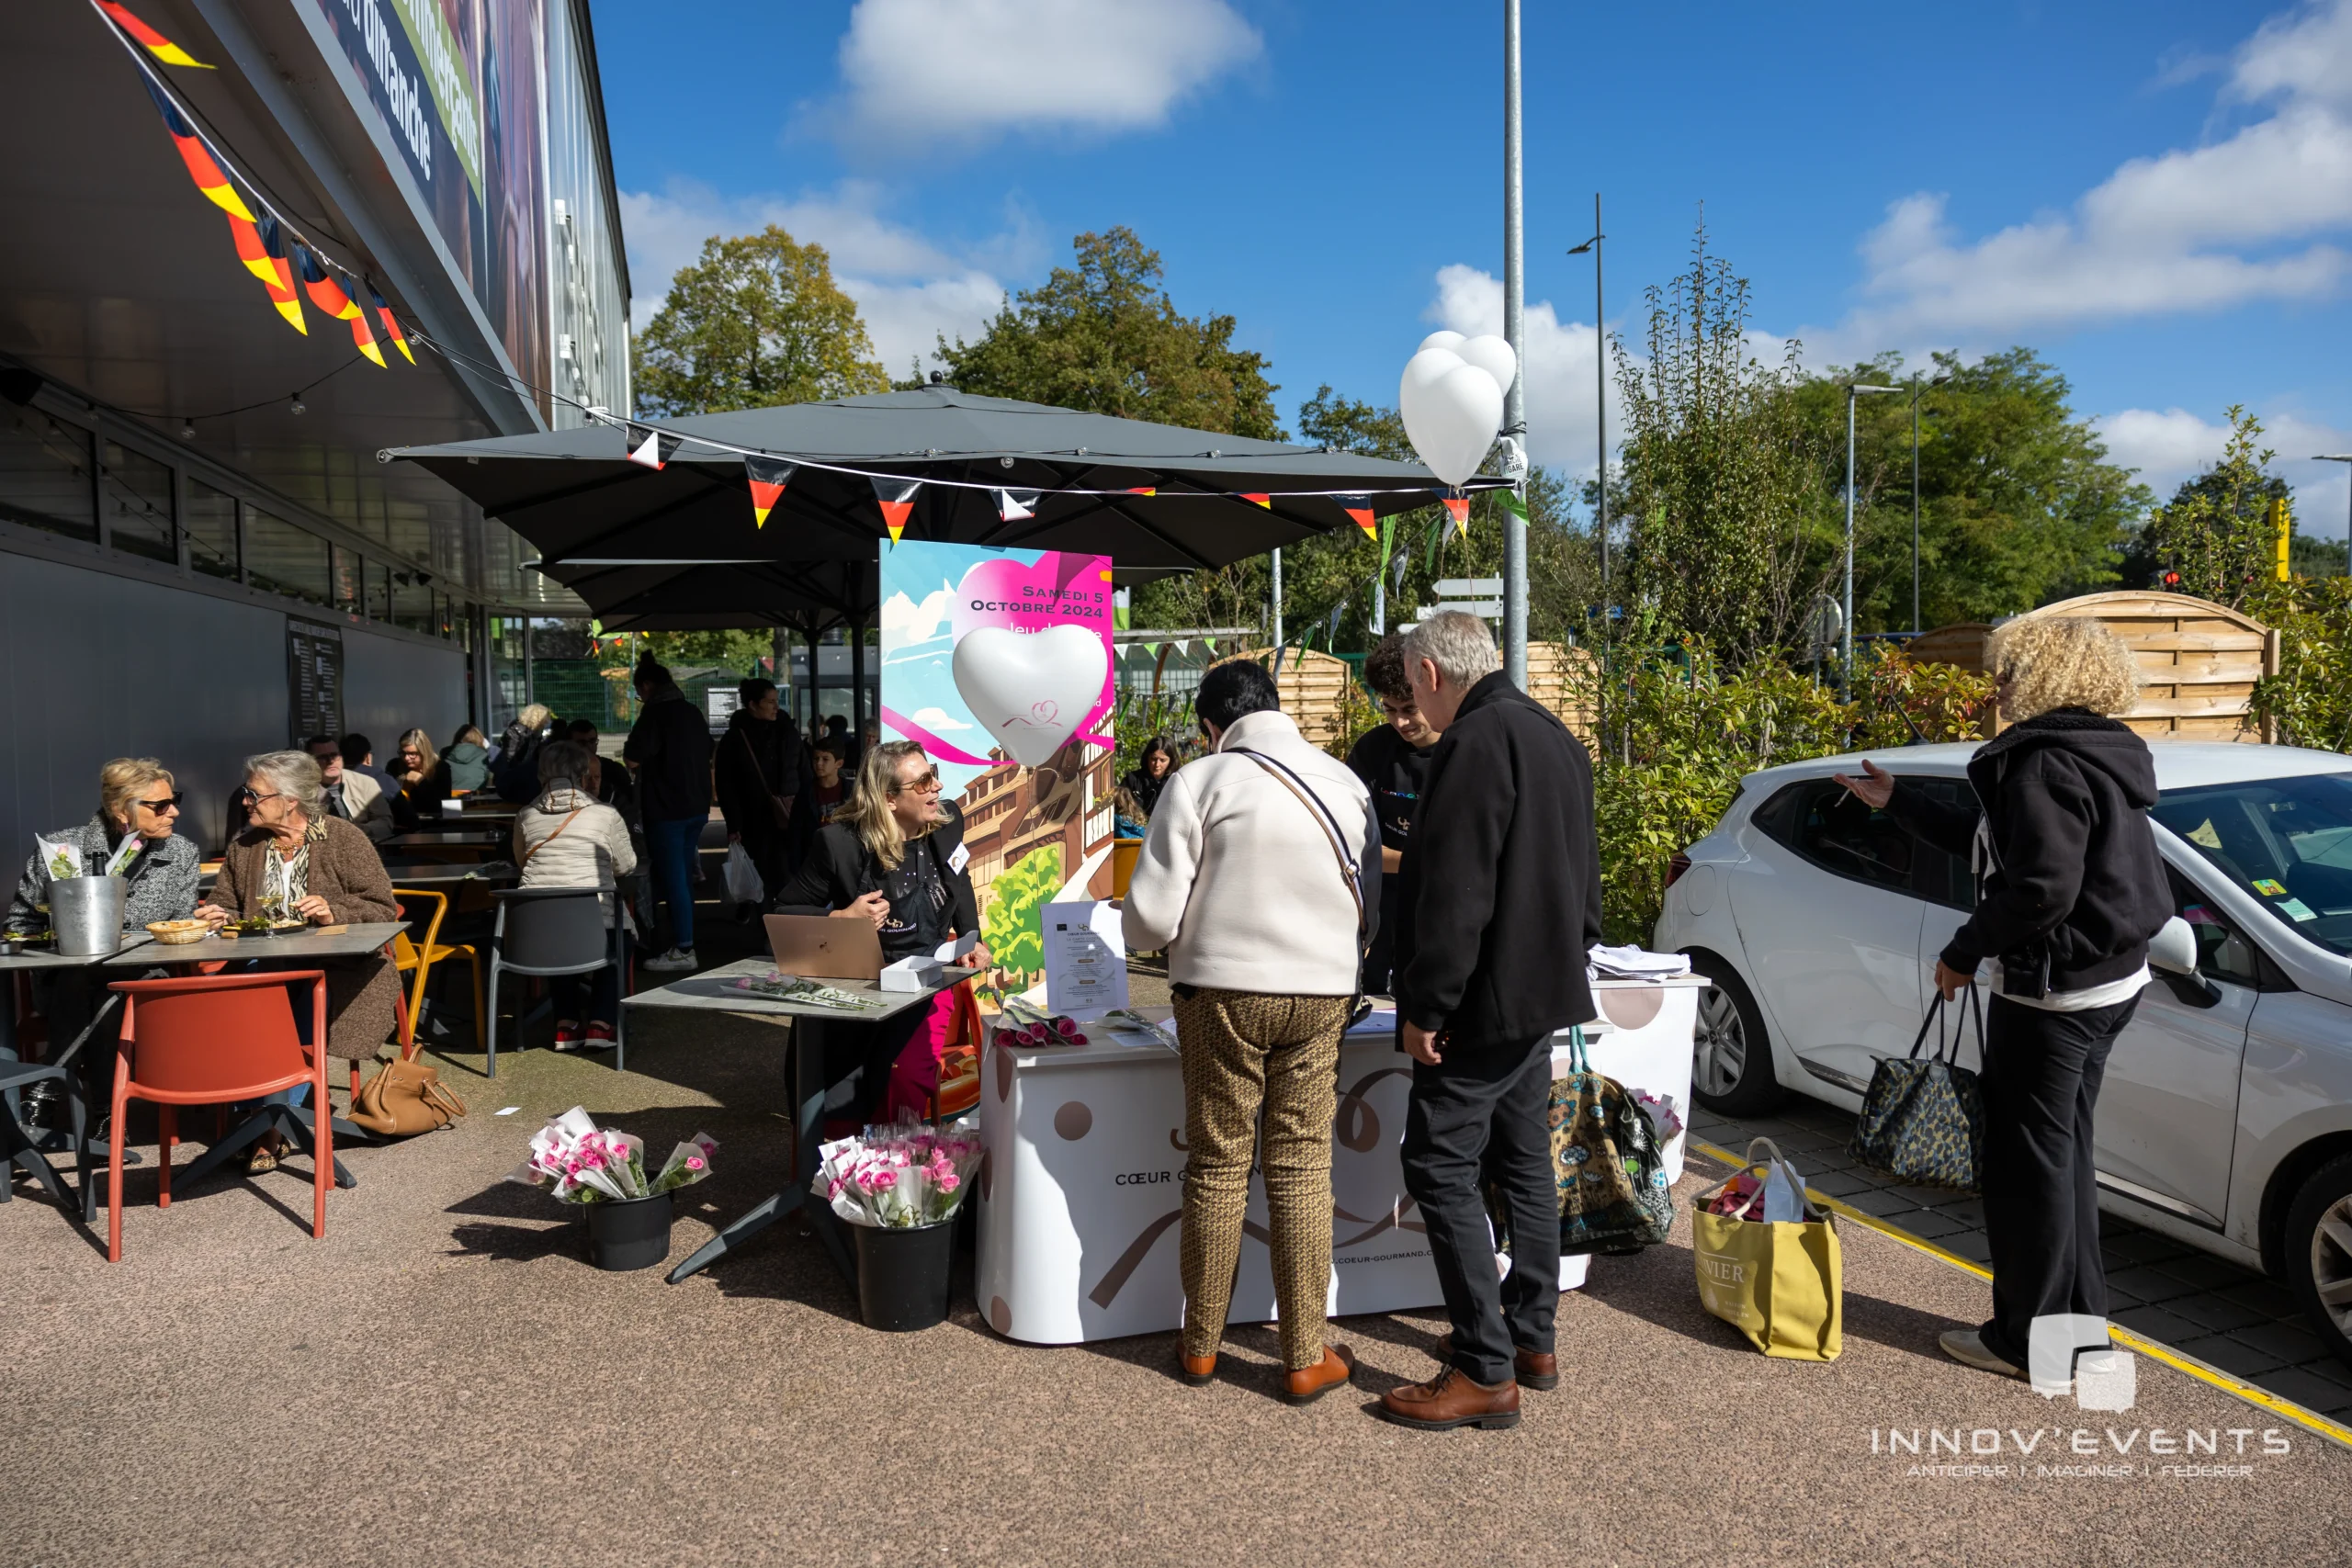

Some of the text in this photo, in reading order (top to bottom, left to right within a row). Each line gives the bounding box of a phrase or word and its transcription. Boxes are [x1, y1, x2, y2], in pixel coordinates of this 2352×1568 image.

[402, 0, 479, 177] mmerçants
[1023, 586, 1103, 604] SAMEDI 5
[970, 600, 1103, 618] OCTOBRE 2024
[1115, 1171, 1170, 1186] CŒUR
